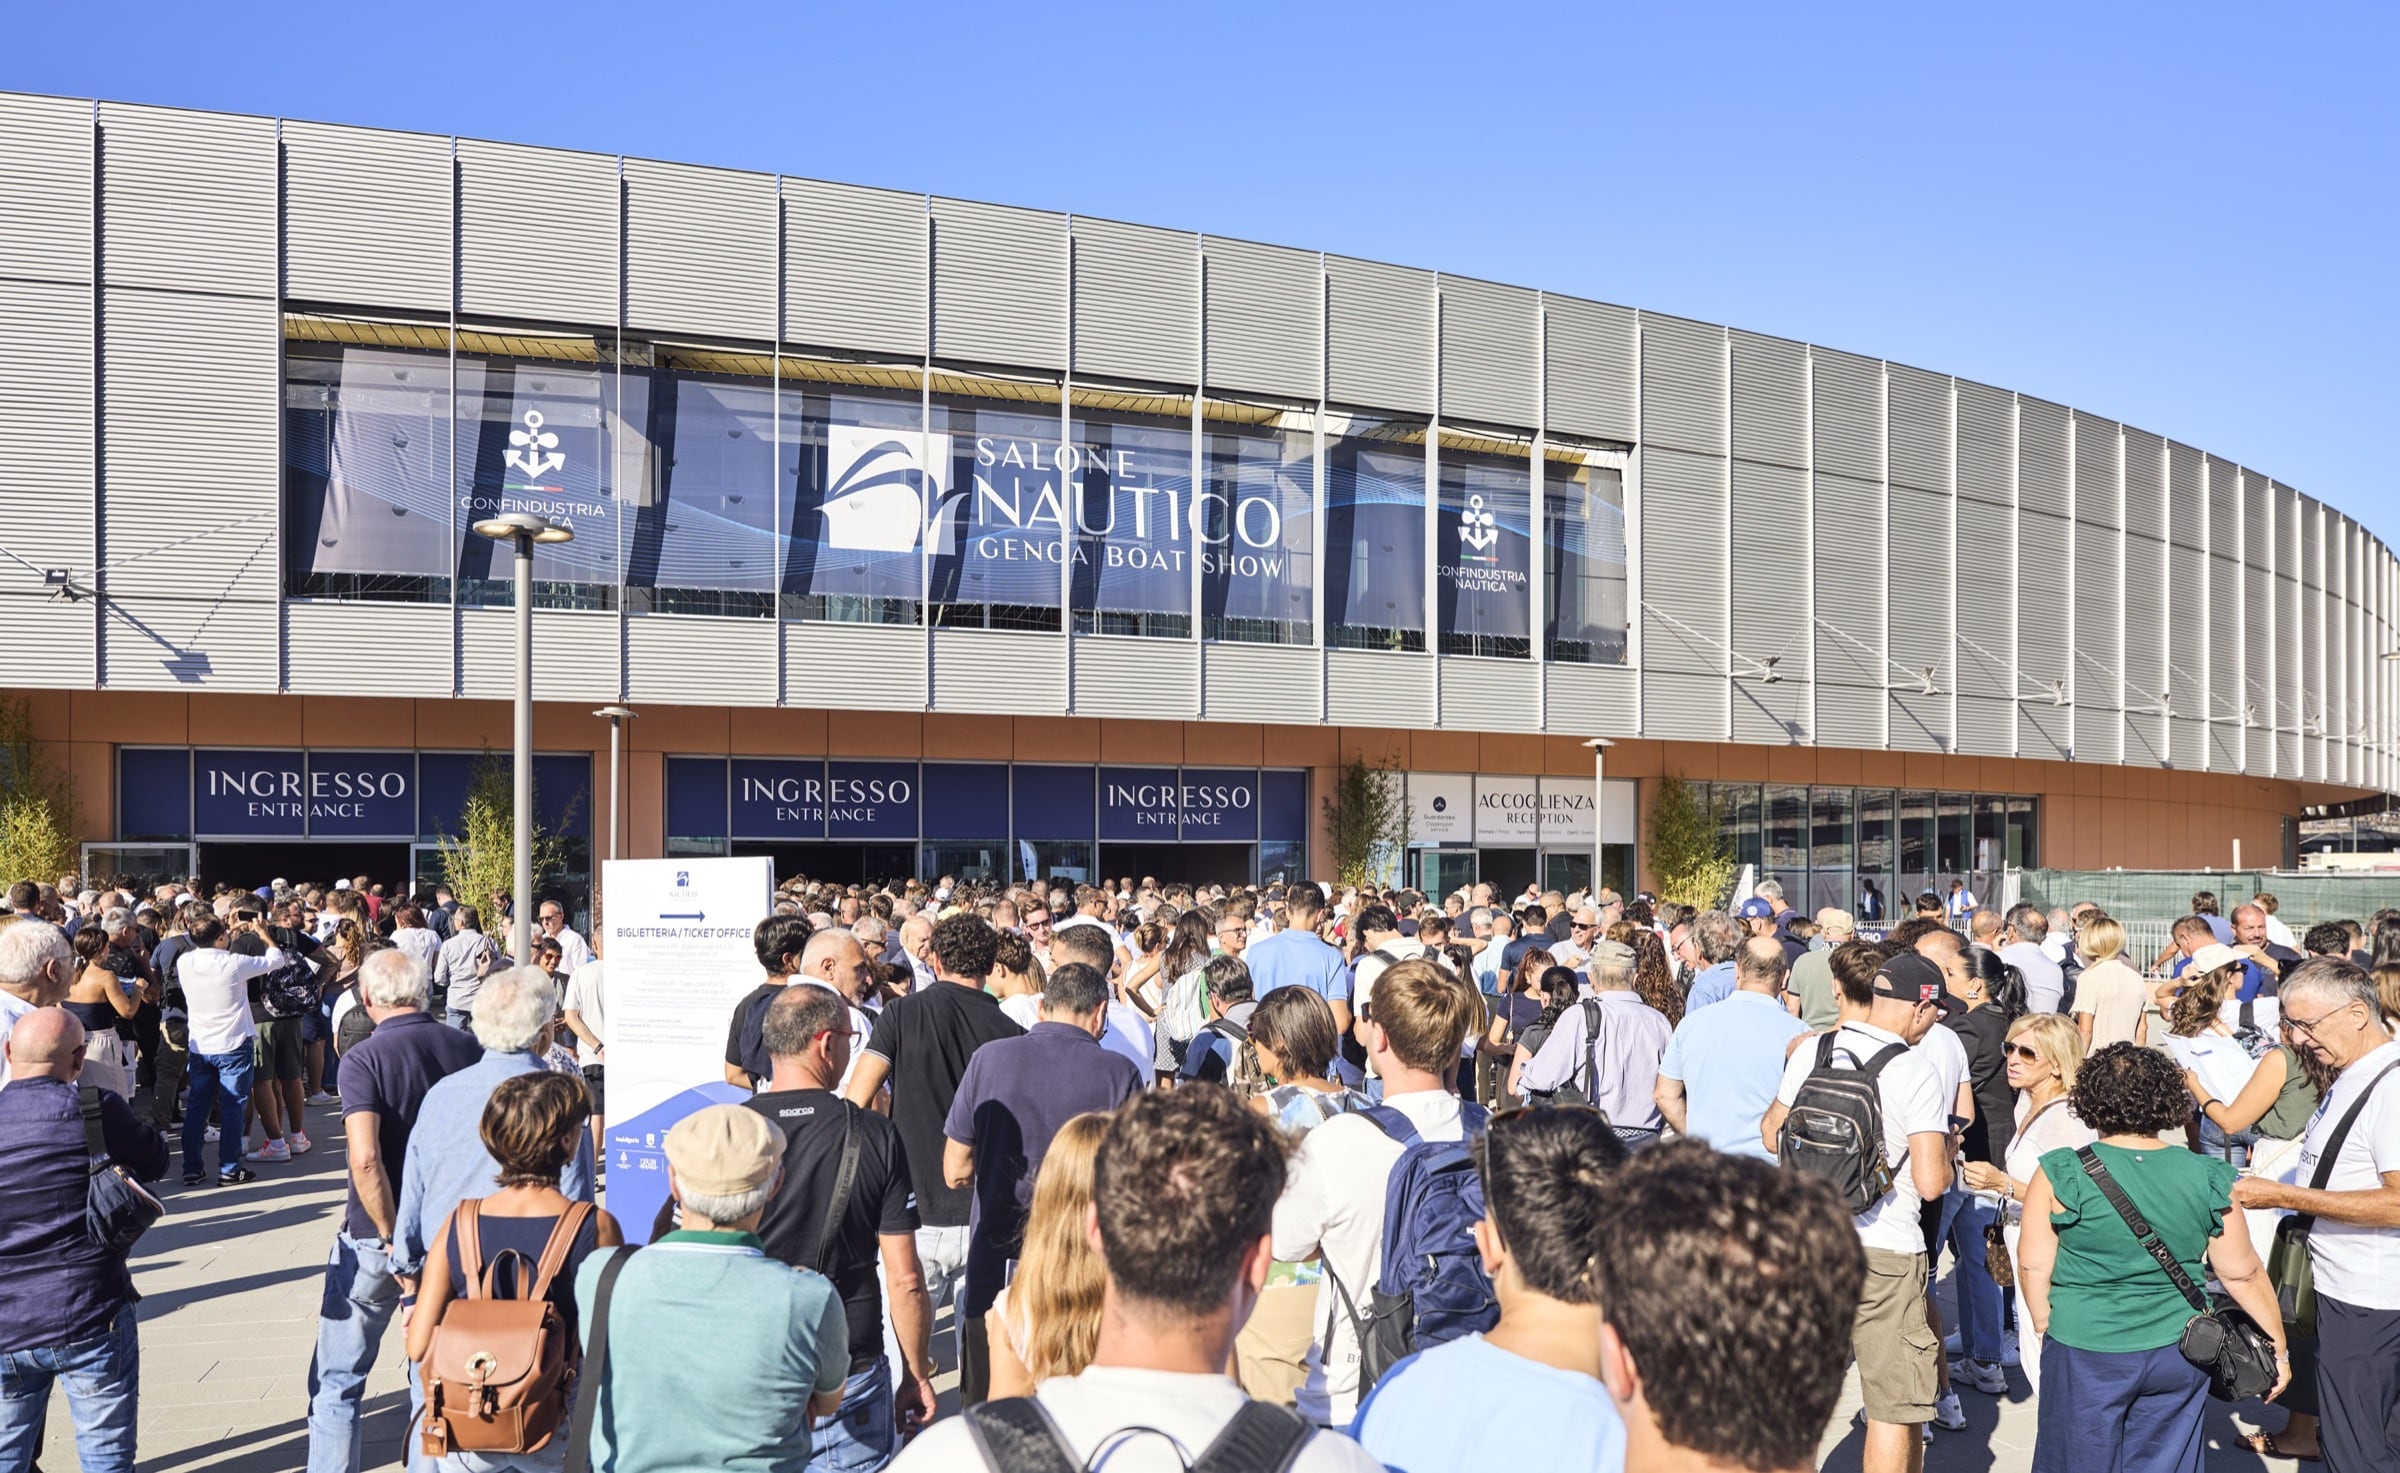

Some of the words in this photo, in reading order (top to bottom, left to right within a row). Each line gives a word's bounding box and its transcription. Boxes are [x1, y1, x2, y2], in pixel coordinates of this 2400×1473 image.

[976, 437, 1136, 479] SALONE
[461, 495, 606, 518] CONFINDUSTRIA
[973, 473, 1281, 548] NAUTICO
[978, 536, 1089, 566] GENOA
[1107, 545, 1186, 572] BOAT
[1201, 552, 1283, 578] SHOW
[1455, 578, 1508, 593] NAUTICA
[208, 770, 406, 798] INGRESSO
[742, 777, 911, 804] INGRESSO
[1107, 784, 1251, 809] INGRESSO
[1478, 792, 1596, 810] ACCOGLIENZA
[248, 802, 366, 818] ENTRANCE
[776, 807, 877, 822] ENTRANCE
[1136, 811, 1222, 826] ENTRANCE
[1506, 812, 1574, 825] RECEPTION
[616, 927, 677, 938] BIGLIETTERIA
[684, 927, 716, 938] TICKET
[716, 928, 751, 939] OFFICE
[779, 1106, 815, 1118] sparco
